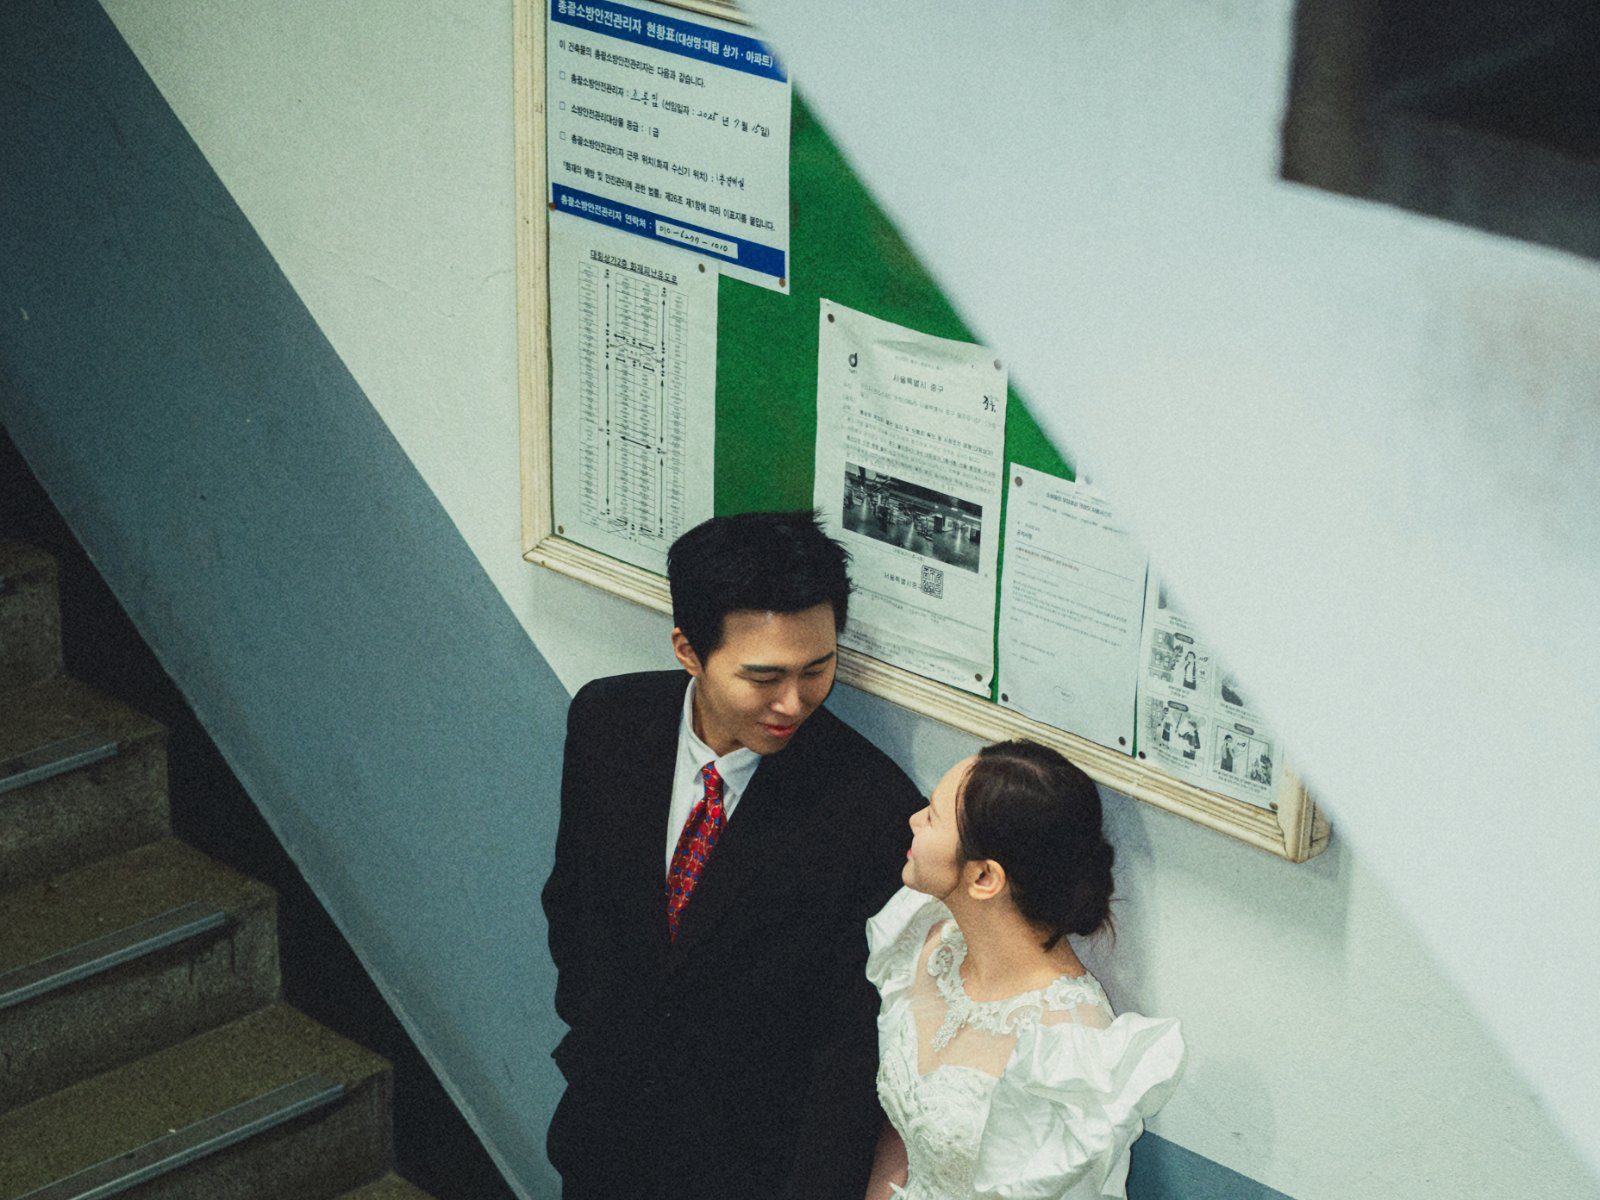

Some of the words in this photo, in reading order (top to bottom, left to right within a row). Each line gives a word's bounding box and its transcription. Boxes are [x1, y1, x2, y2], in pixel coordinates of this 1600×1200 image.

[558, 0, 642, 34] 총괄소방안전관리자
[723, 44, 739, 60] 상가
[746, 51, 773, 68] 아파트)
[559, 40, 566, 50] 이
[568, 42, 592, 57] 건축물의
[657, 66, 676, 80] 다음과
[626, 150, 639, 161] 근무
[671, 163, 691, 178] 수신기
[560, 194, 622, 222] 총괄소방안전관리자
[624, 213, 647, 229] 연락처
